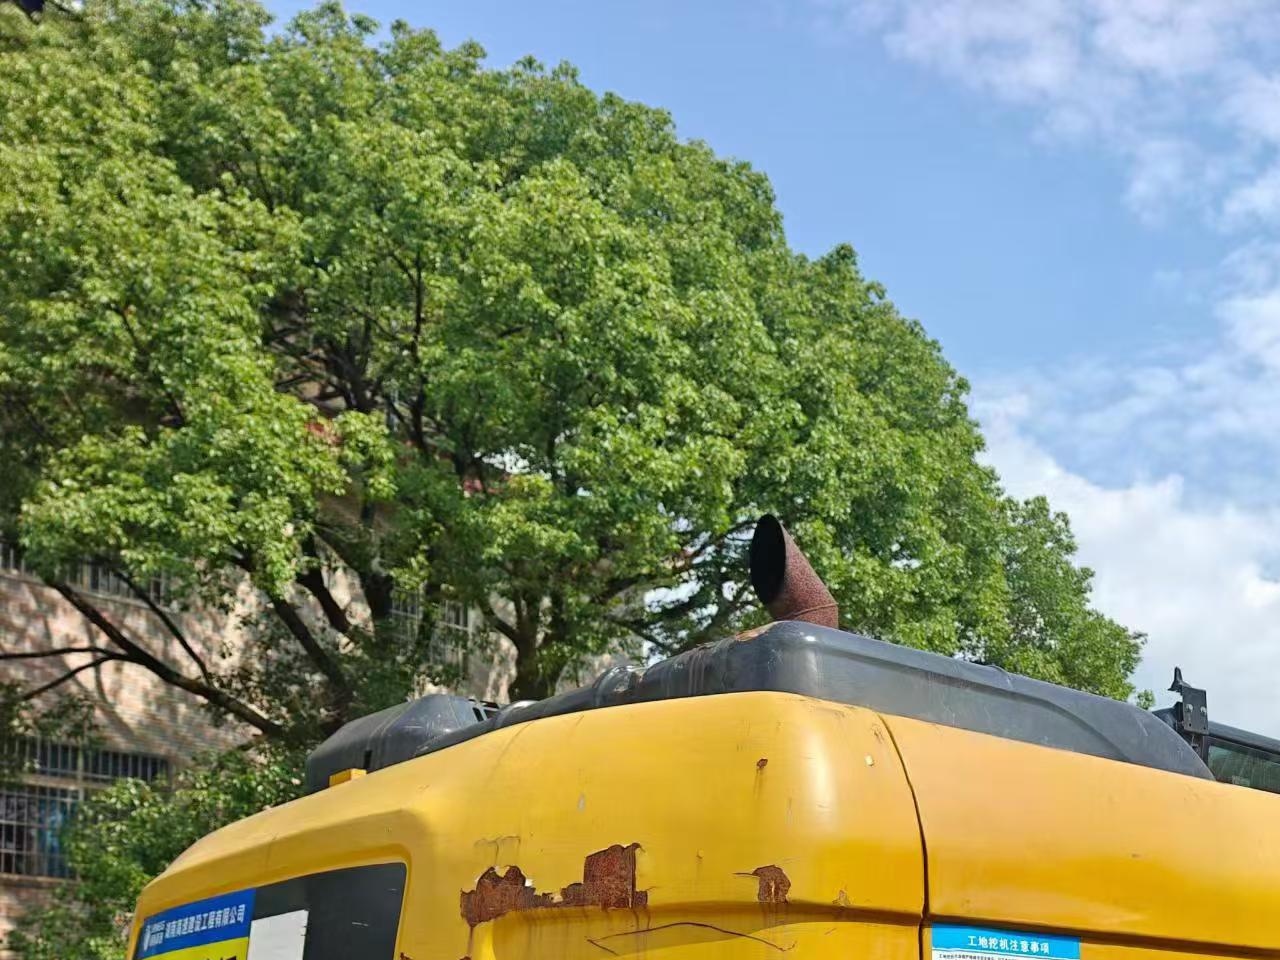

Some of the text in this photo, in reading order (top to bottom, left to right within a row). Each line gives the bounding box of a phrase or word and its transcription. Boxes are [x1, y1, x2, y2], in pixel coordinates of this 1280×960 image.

[967, 935, 1050, 954] 工地挖机注意事项
